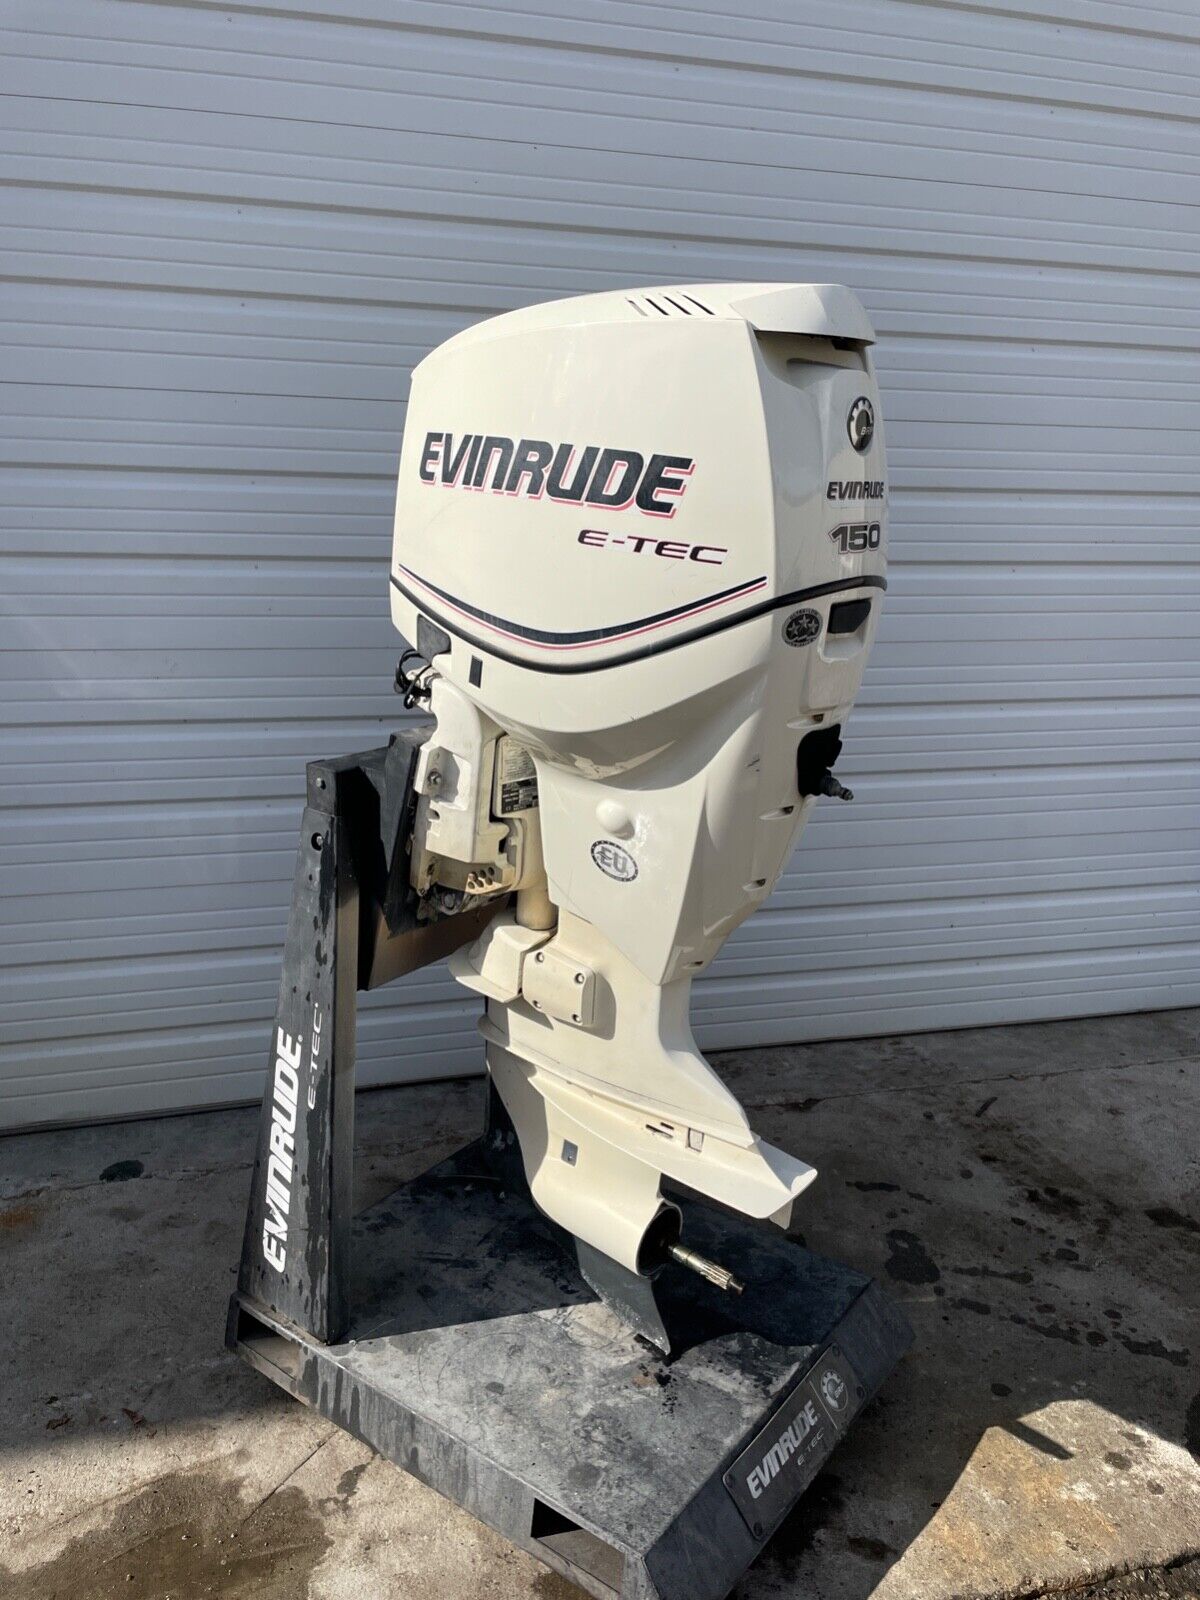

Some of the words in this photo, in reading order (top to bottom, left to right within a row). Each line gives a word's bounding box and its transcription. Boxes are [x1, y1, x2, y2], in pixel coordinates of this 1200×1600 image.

[418, 431, 696, 519] EVINRUDE
[826, 481, 884, 500] EVINRUDE
[577, 529, 728, 565] E-TEC
[828, 521, 881, 554] 150
[307, 1007, 322, 1110] E-TEC
[262, 1026, 301, 1273] EVINRUDE
[746, 1400, 818, 1499] EVINRUDE
